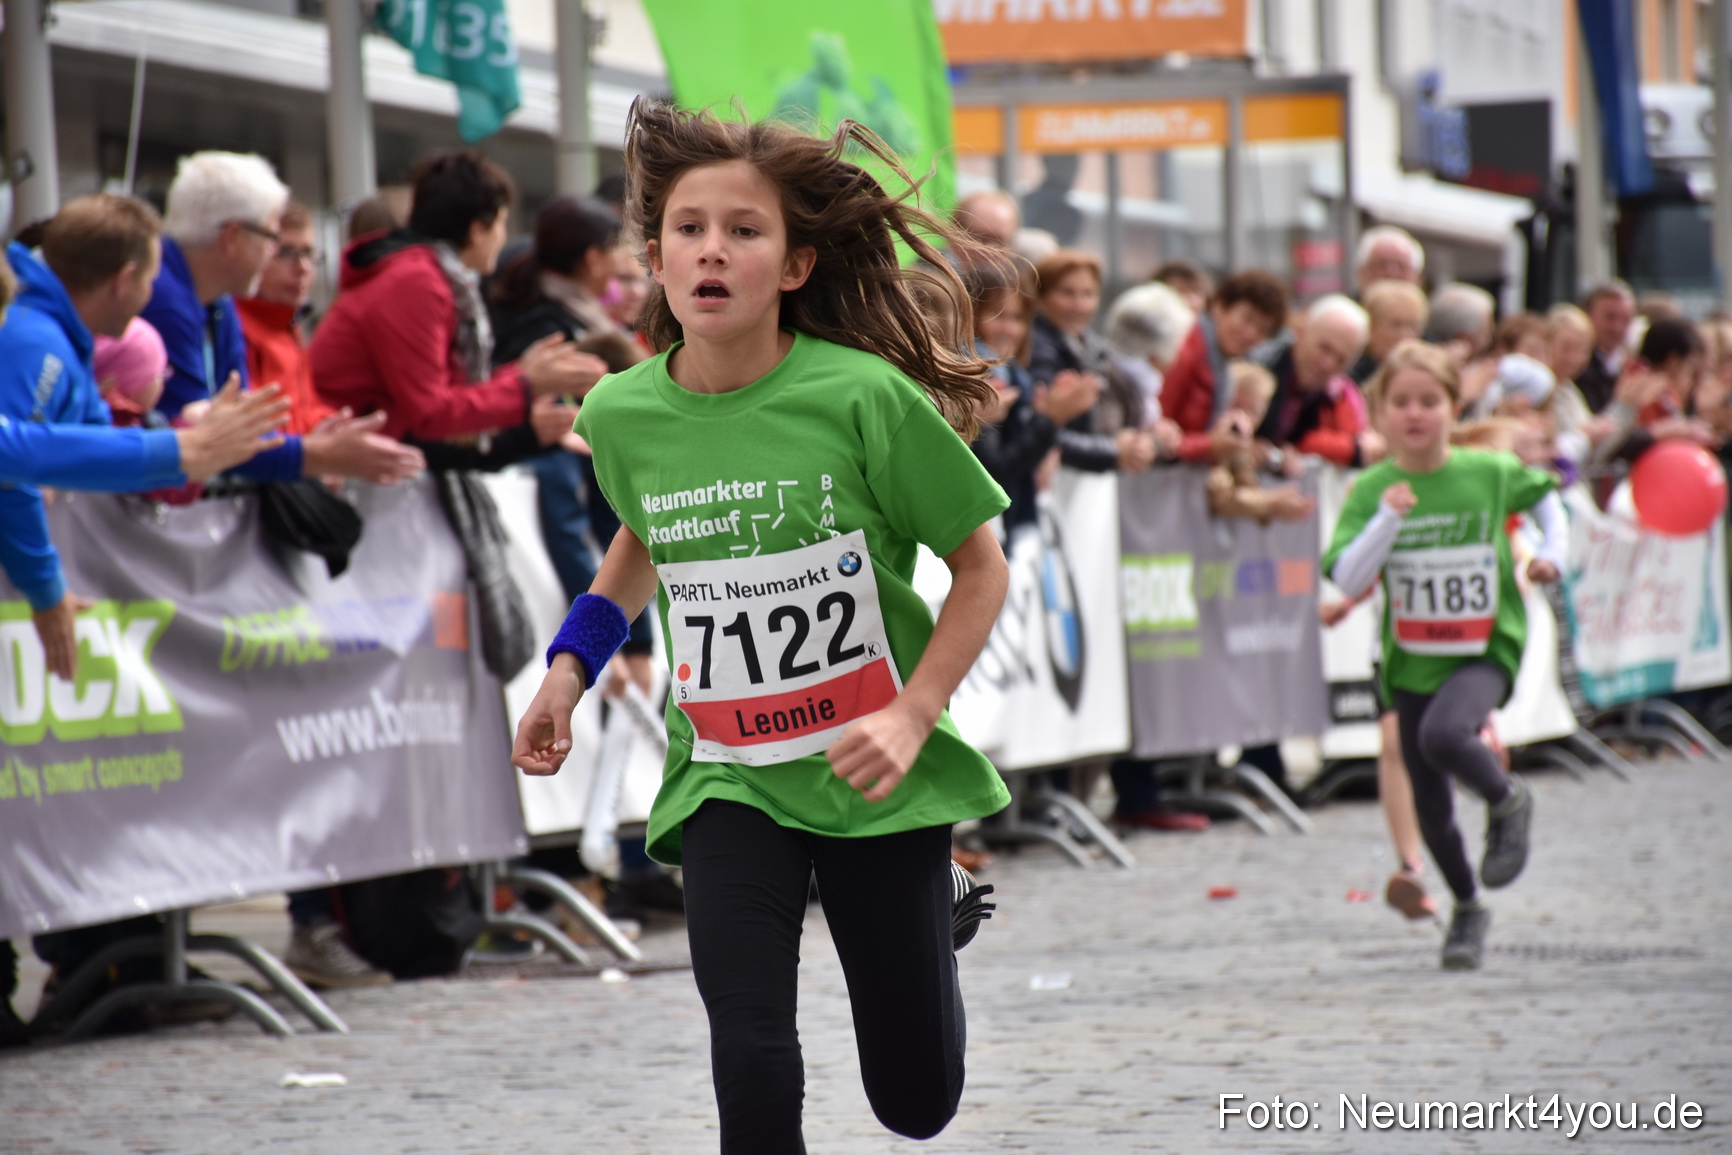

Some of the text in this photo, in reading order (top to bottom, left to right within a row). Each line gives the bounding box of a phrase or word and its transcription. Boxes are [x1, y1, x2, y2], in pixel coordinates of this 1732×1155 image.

[640, 479, 767, 514] Neumarkter
[670, 566, 831, 603] PARTL Neumarkt
[1398, 573, 1489, 614] 7183
[684, 590, 866, 690] 7122
[867, 645, 877, 657] K
[680, 686, 688, 700] 5
[735, 697, 836, 738] Leonie
[98, 748, 184, 793] concepts
